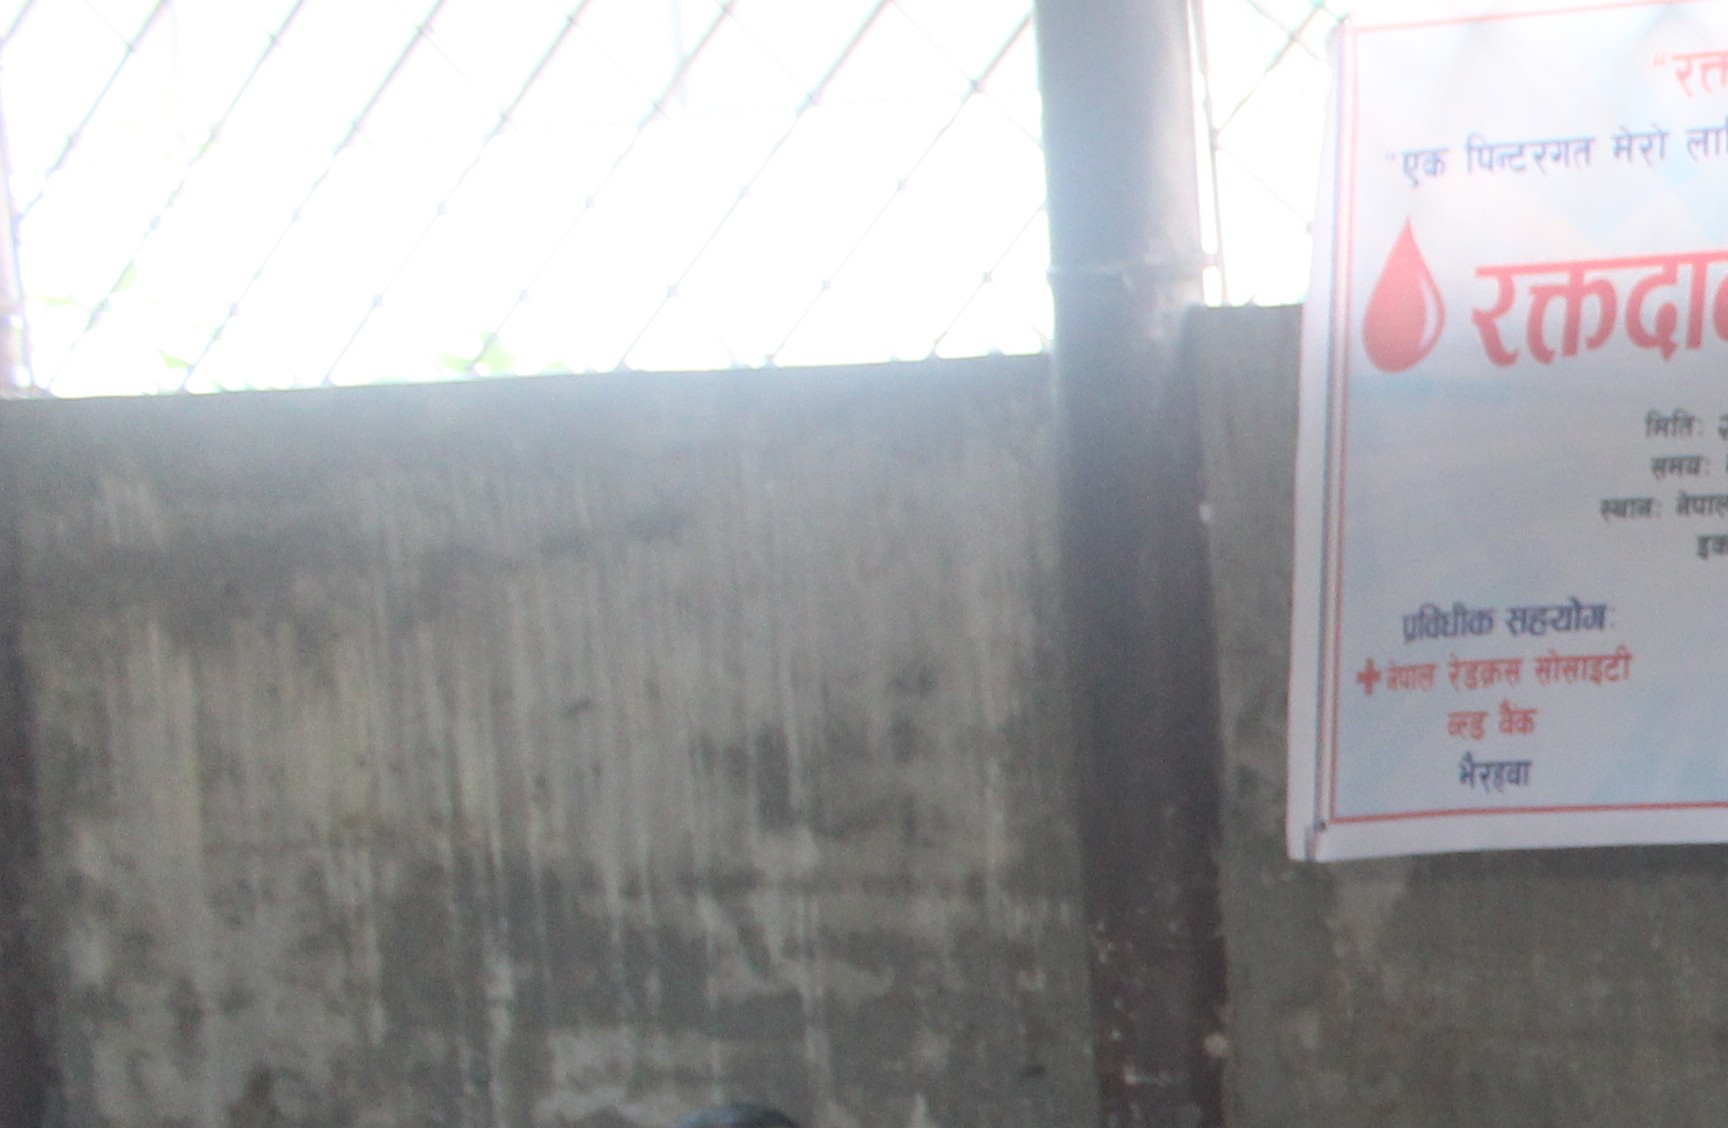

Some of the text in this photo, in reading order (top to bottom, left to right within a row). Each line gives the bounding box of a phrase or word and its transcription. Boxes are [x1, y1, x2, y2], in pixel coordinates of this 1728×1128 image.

[1610, 125, 1669, 165] मेरो
[1386, 660, 1438, 691] नेपाल
[1458, 752, 1532, 792] भैरहवा
